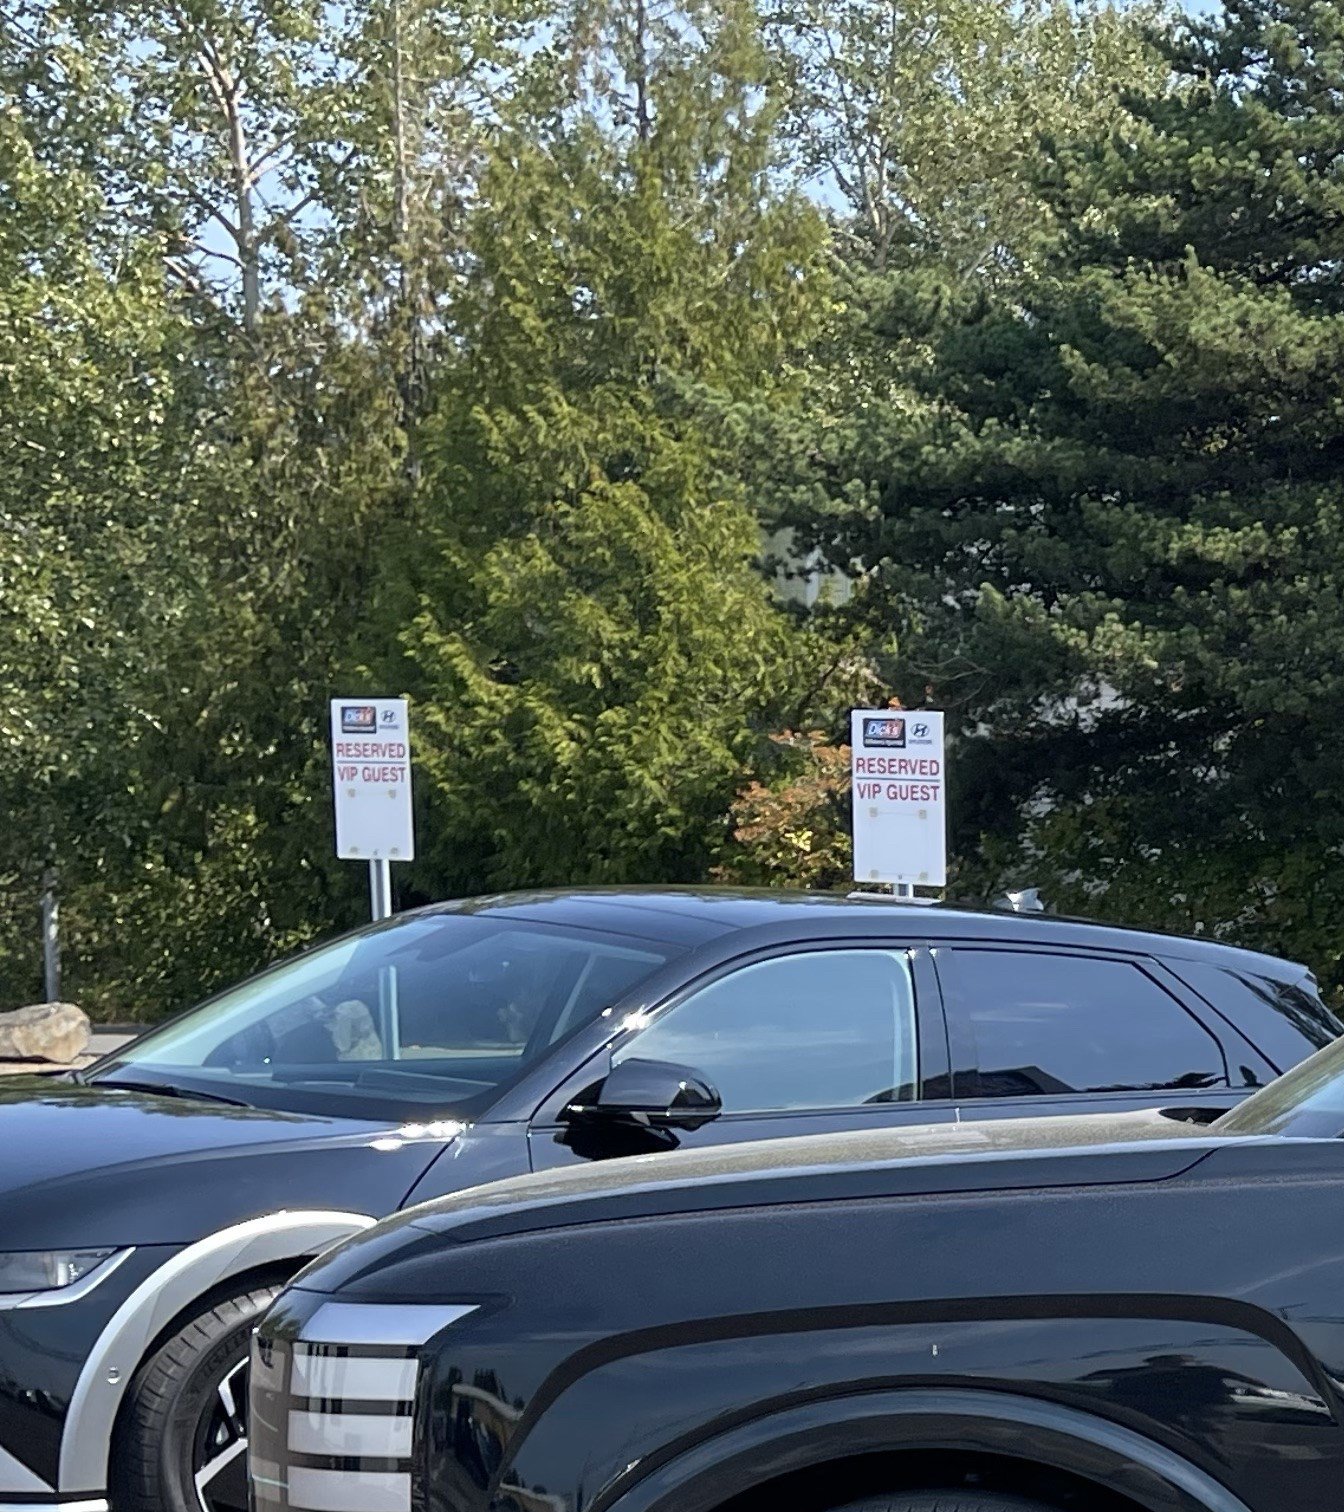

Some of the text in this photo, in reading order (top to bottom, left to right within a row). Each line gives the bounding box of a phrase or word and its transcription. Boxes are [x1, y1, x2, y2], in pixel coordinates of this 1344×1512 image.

[336, 743, 406, 758] RESERVED
[856, 757, 940, 775] RESERVED
[337, 767, 406, 782] VIP GUEST
[857, 783, 940, 801] VIP GUEST
